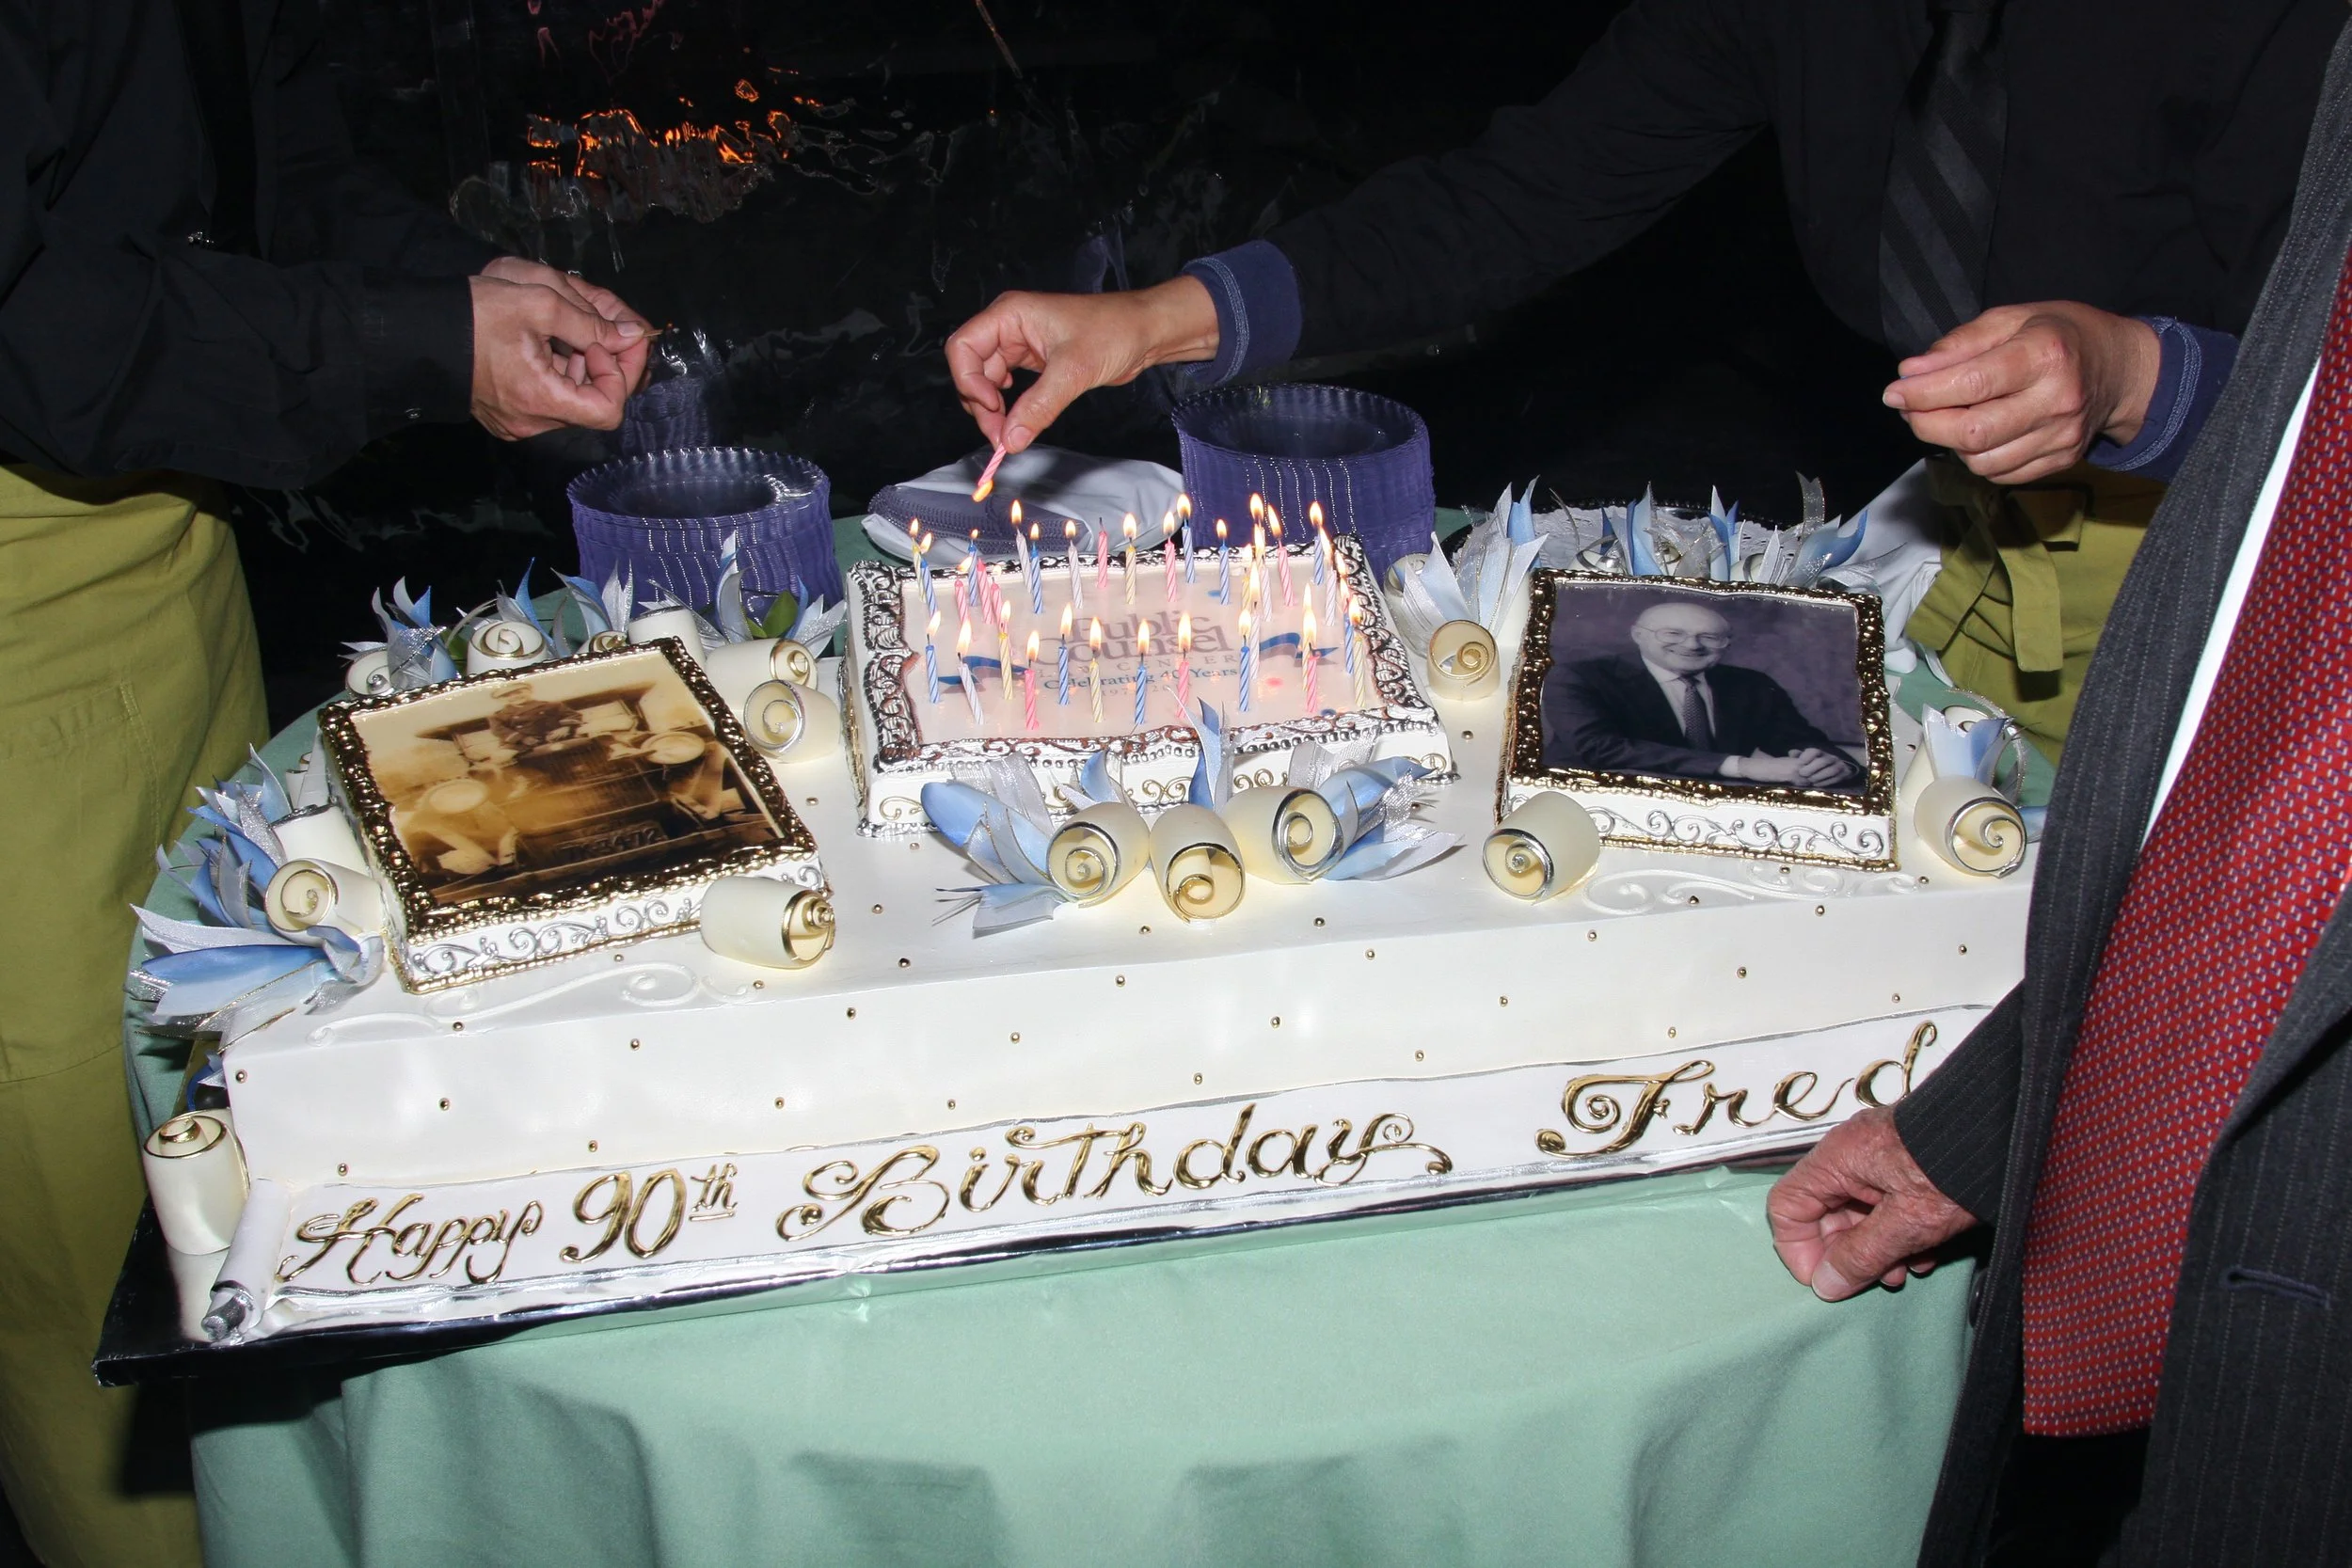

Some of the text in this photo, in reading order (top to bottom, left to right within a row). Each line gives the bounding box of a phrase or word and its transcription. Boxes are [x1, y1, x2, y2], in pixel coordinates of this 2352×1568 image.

[1068, 610, 1212, 643] Public
[1033, 625, 1234, 665] Counsel
[1043, 673, 1156, 689] Clerating
[1189, 668, 1238, 678] Years
[1117, 655, 1238, 672] CNER
[276, 1020, 1939, 1285] Happy 90th Birthday Fred
